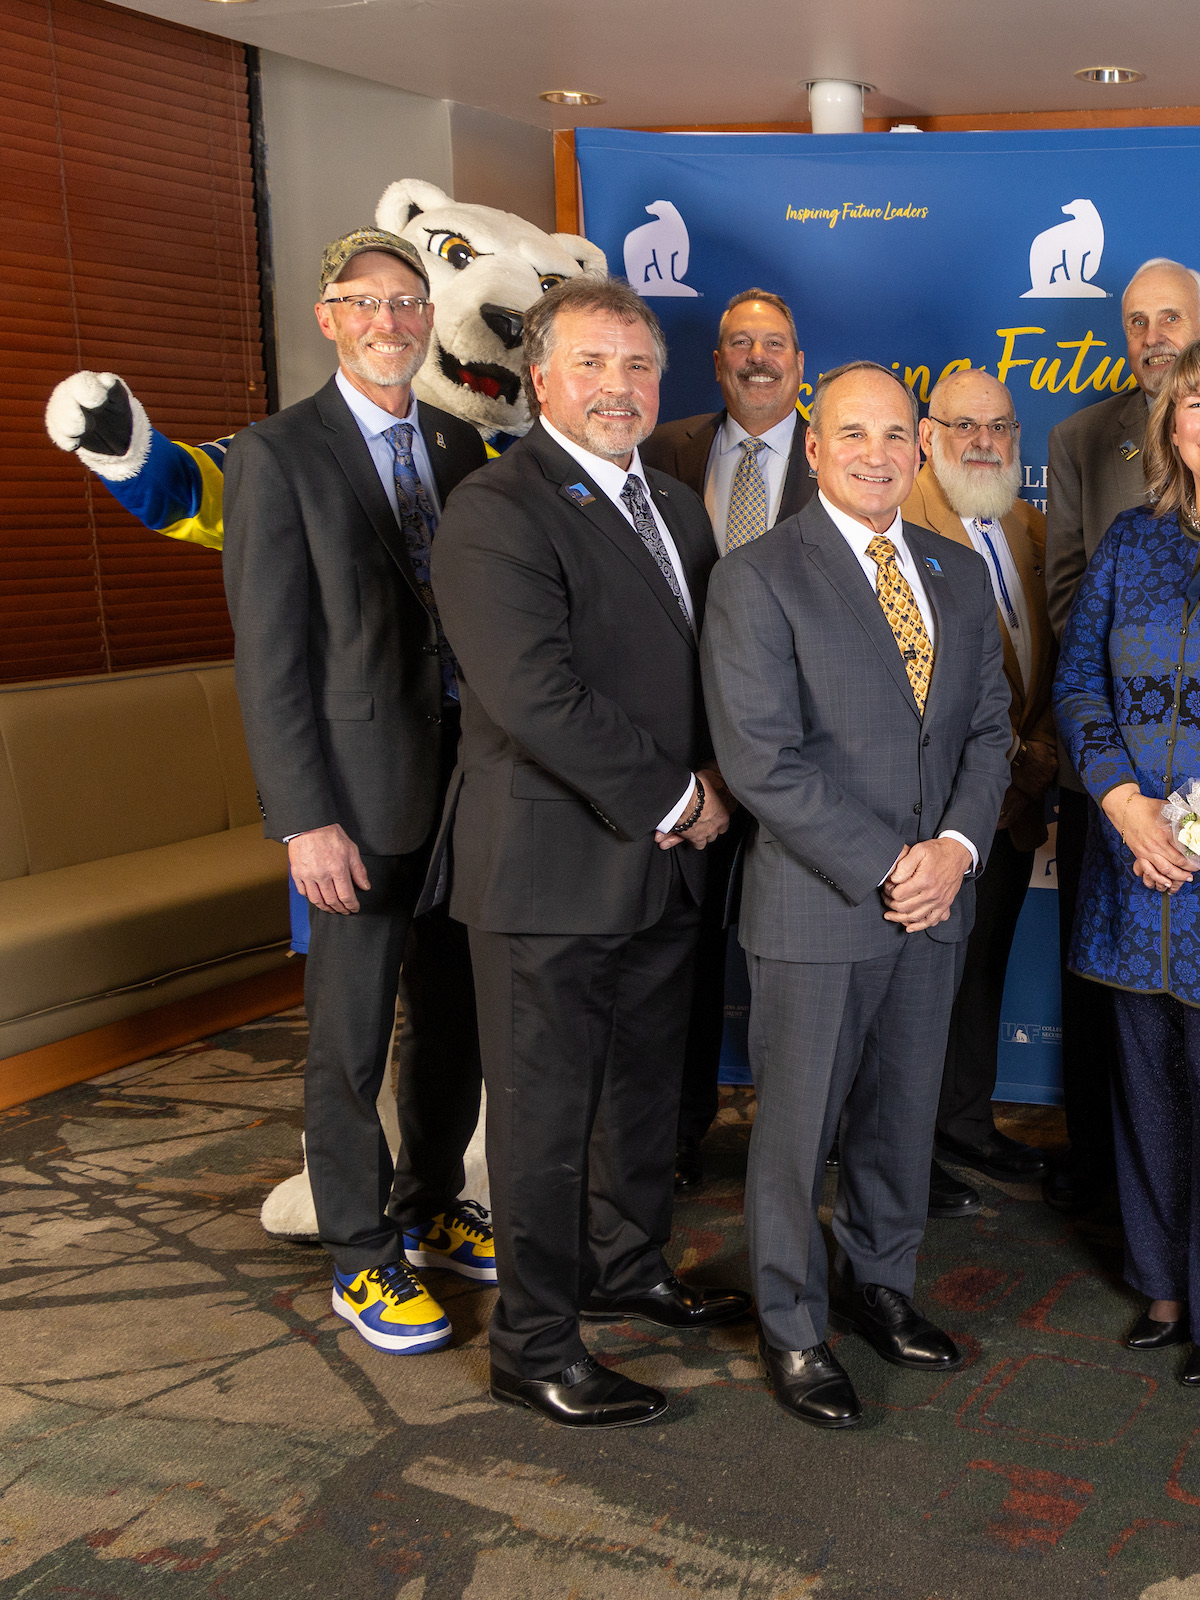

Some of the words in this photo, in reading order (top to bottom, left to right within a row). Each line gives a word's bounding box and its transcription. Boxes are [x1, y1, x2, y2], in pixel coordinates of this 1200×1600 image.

[786, 204, 840, 228] Inspiring
[842, 202, 883, 220] Future
[883, 201, 929, 220] Leaders
[996, 326, 1138, 394] Futu
[1001, 1022, 1041, 1043] UAF
